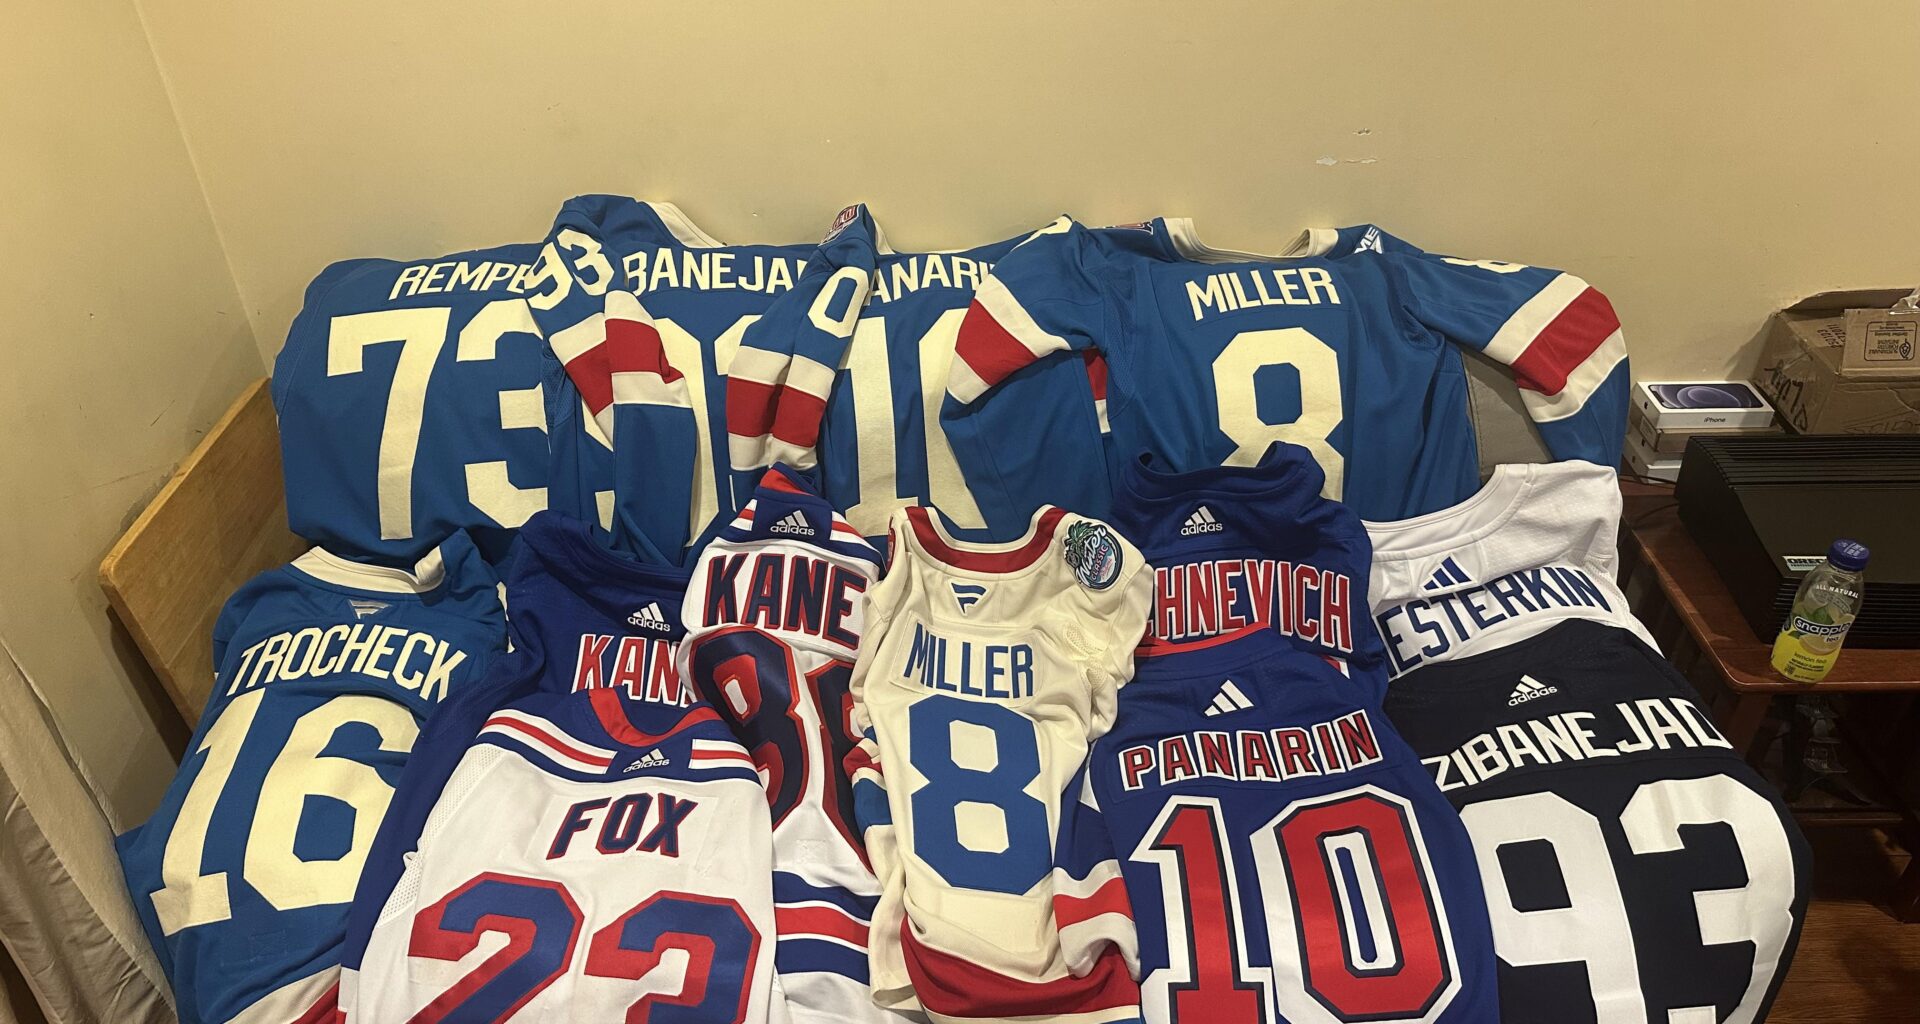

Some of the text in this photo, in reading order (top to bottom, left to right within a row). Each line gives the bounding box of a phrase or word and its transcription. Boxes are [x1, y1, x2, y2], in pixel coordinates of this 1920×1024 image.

[524, 228, 615, 311] 93
[622, 247, 808, 296] BANEJA
[864, 254, 996, 306] ANARI
[1185, 266, 1341, 321] MILLER
[1212, 327, 1343, 502] 8
[770, 523, 815, 536] adidas
[1091, 544, 1109, 580] CLASSIC
[1181, 520, 1222, 535] adidas
[627, 616, 670, 632] adidas
[703, 553, 866, 650] KANE
[1142, 559, 1353, 654] HNEVICH
[1376, 566, 1612, 678] ESTERKIN
[227, 623, 466, 703] TROCHECK
[571, 634, 697, 708] KAN
[904, 624, 1034, 698] MILLER
[1508, 684, 1558, 706] adidas
[623, 758, 670, 773] adidas
[1119, 709, 1384, 791] PANARIN
[150, 687, 421, 937] 16
[546, 793, 698, 861] FOX
[909, 693, 1051, 896] 8
[1129, 784, 1462, 1024] 10
[1457, 774, 1795, 1024] 93
